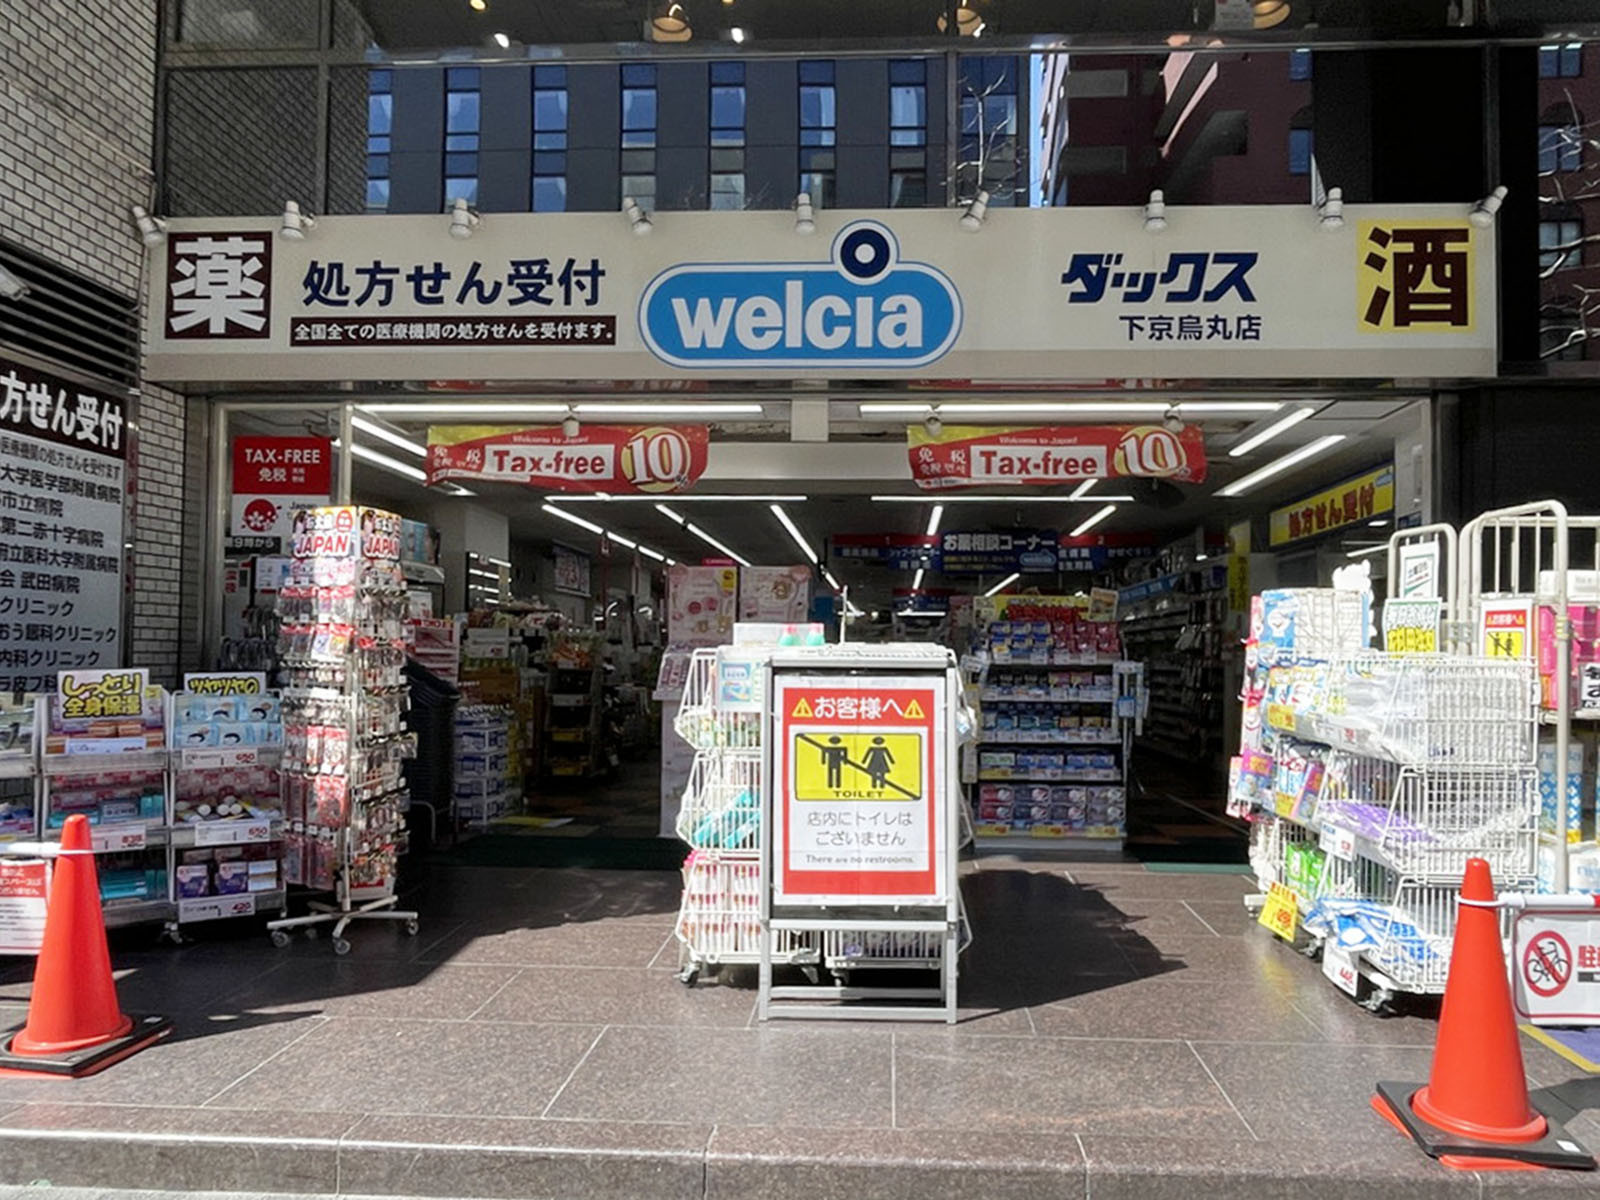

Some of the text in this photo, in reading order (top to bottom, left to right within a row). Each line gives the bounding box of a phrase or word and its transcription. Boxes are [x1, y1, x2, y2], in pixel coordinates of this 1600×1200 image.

[169, 236, 267, 334] 薬
[303, 258, 606, 308] 処方せん受付
[1061, 253, 1259, 303] ダックス
[1364, 227, 1469, 327] 酒
[671, 229, 922, 351] welcia
[295, 322, 616, 342] 全国全ての医療機関の処方せんを受付ます。
[1119, 314, 1262, 341] 下京烏丸店
[245, 449, 320, 463] TAX-FREE
[493, 450, 605, 474] Tax-free
[979, 450, 1097, 475] Tax-free
[295, 535, 348, 554] JAPAN
[63, 672, 142, 697] しっとり
[63, 695, 142, 718] 全身保湿
[814, 696, 903, 720] お客様へ
[807, 810, 913, 826] 店内にトイレは
[816, 830, 906, 847] ございません
[806, 854, 833, 864] There
[851, 856, 863, 864] no
